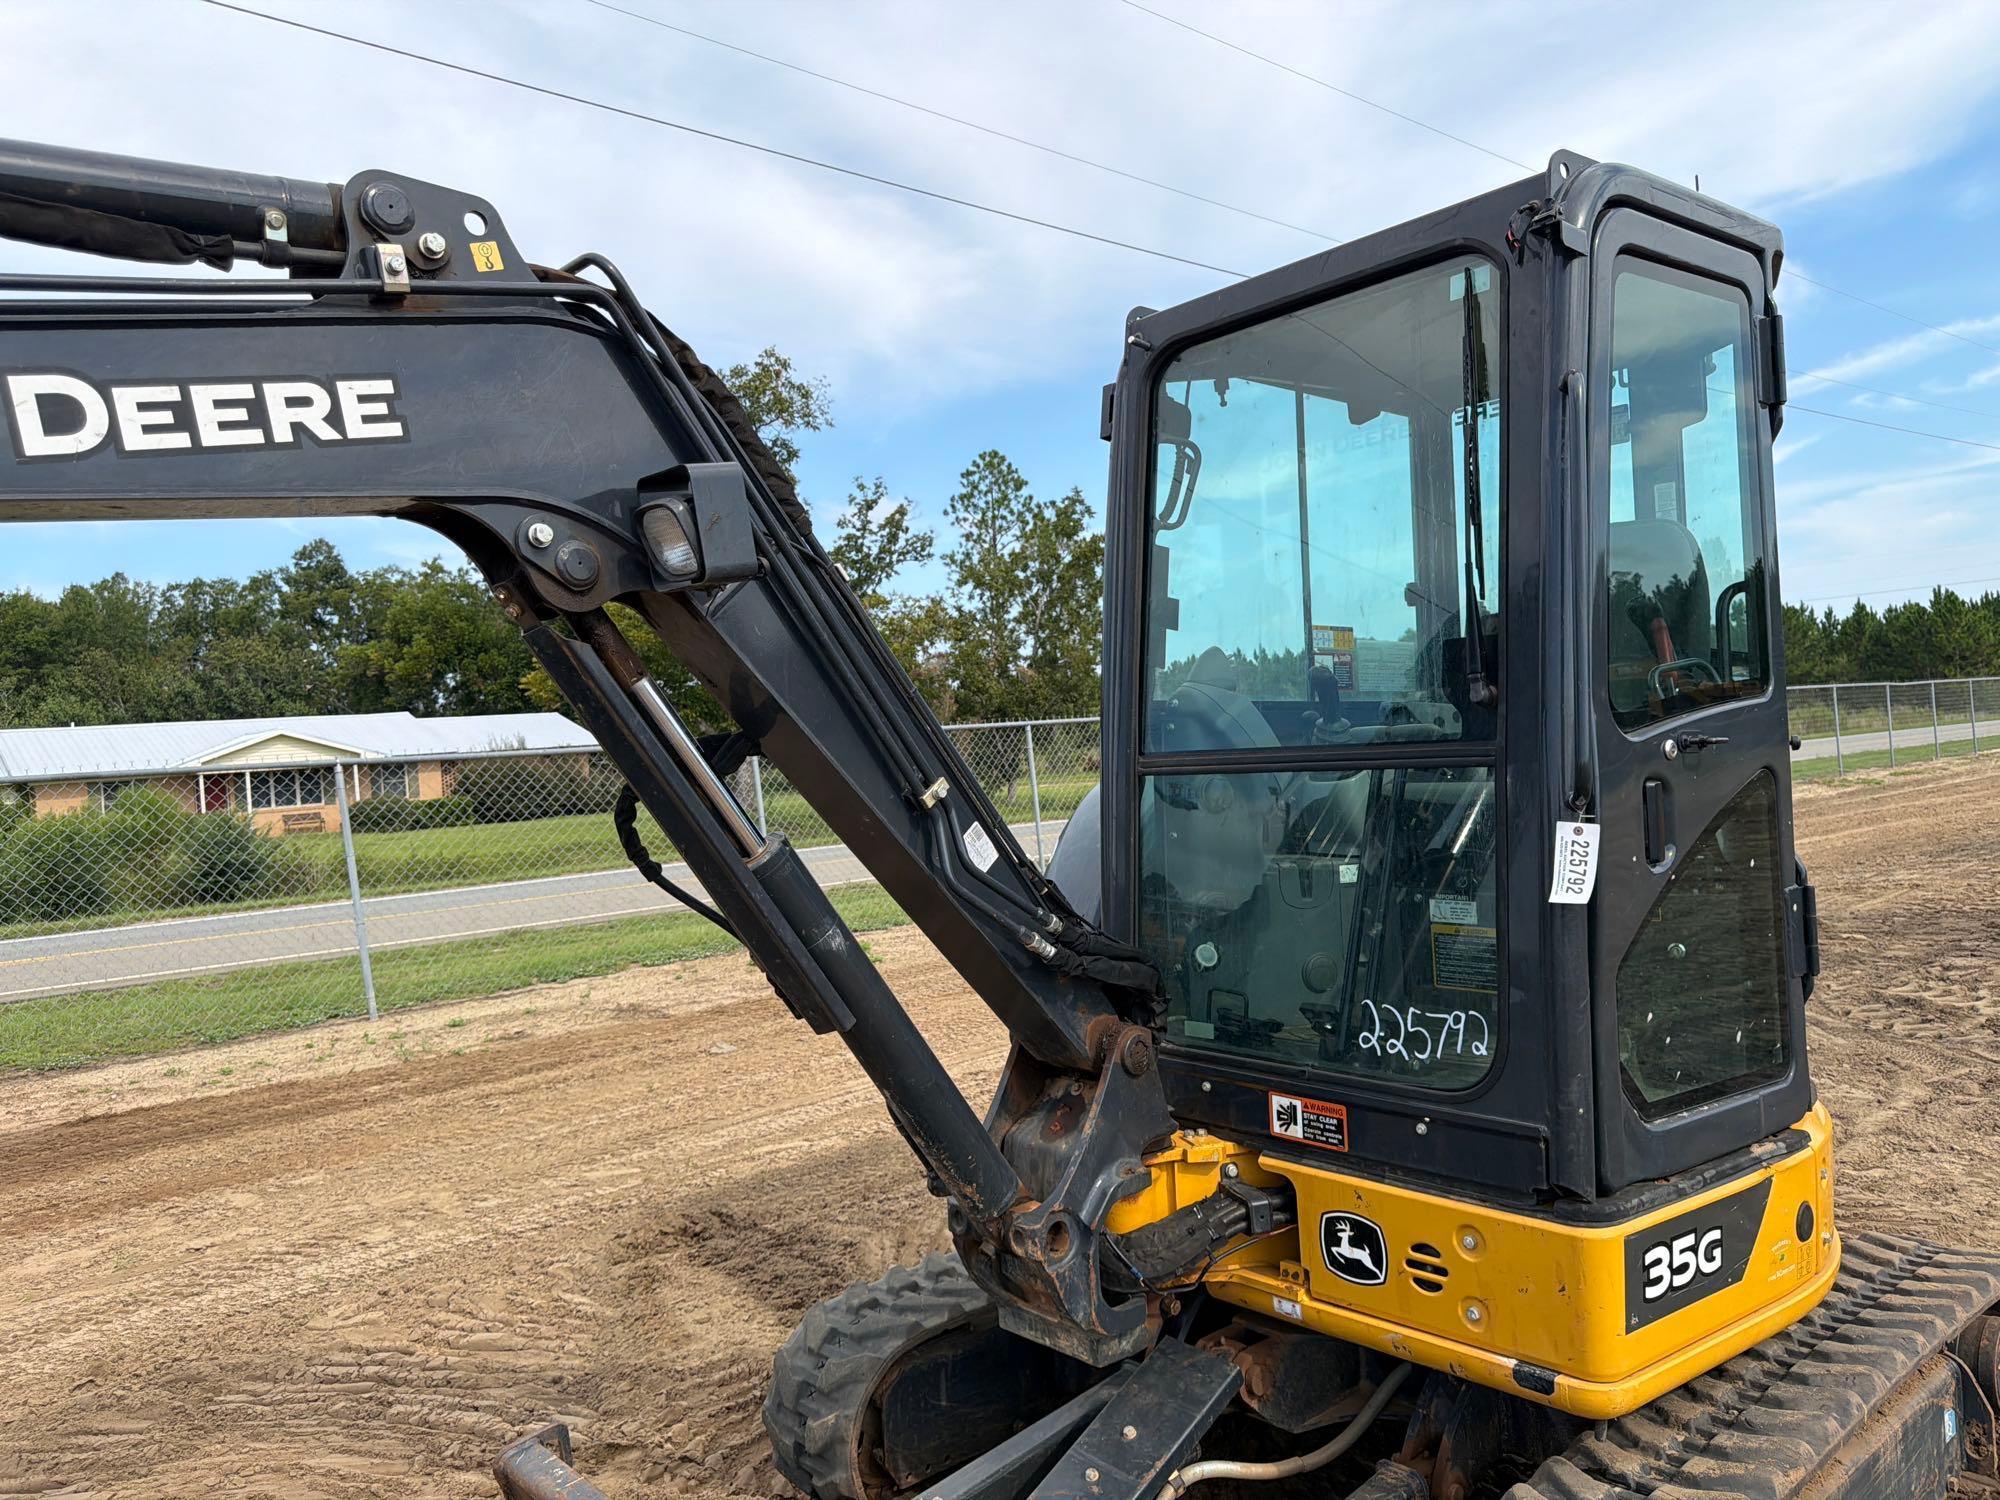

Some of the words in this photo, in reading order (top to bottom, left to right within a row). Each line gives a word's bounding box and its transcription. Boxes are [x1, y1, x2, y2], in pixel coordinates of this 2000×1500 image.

[6, 374, 404, 457] DEERE
[1565, 839, 1590, 895] 225792
[1358, 999, 1489, 1060] 225792
[1303, 1112, 1318, 1121] STAY
[1319, 1116, 1338, 1125] CLEAR
[1310, 1103, 1343, 1116] WARNING
[1643, 1227, 1722, 1301] 35G
